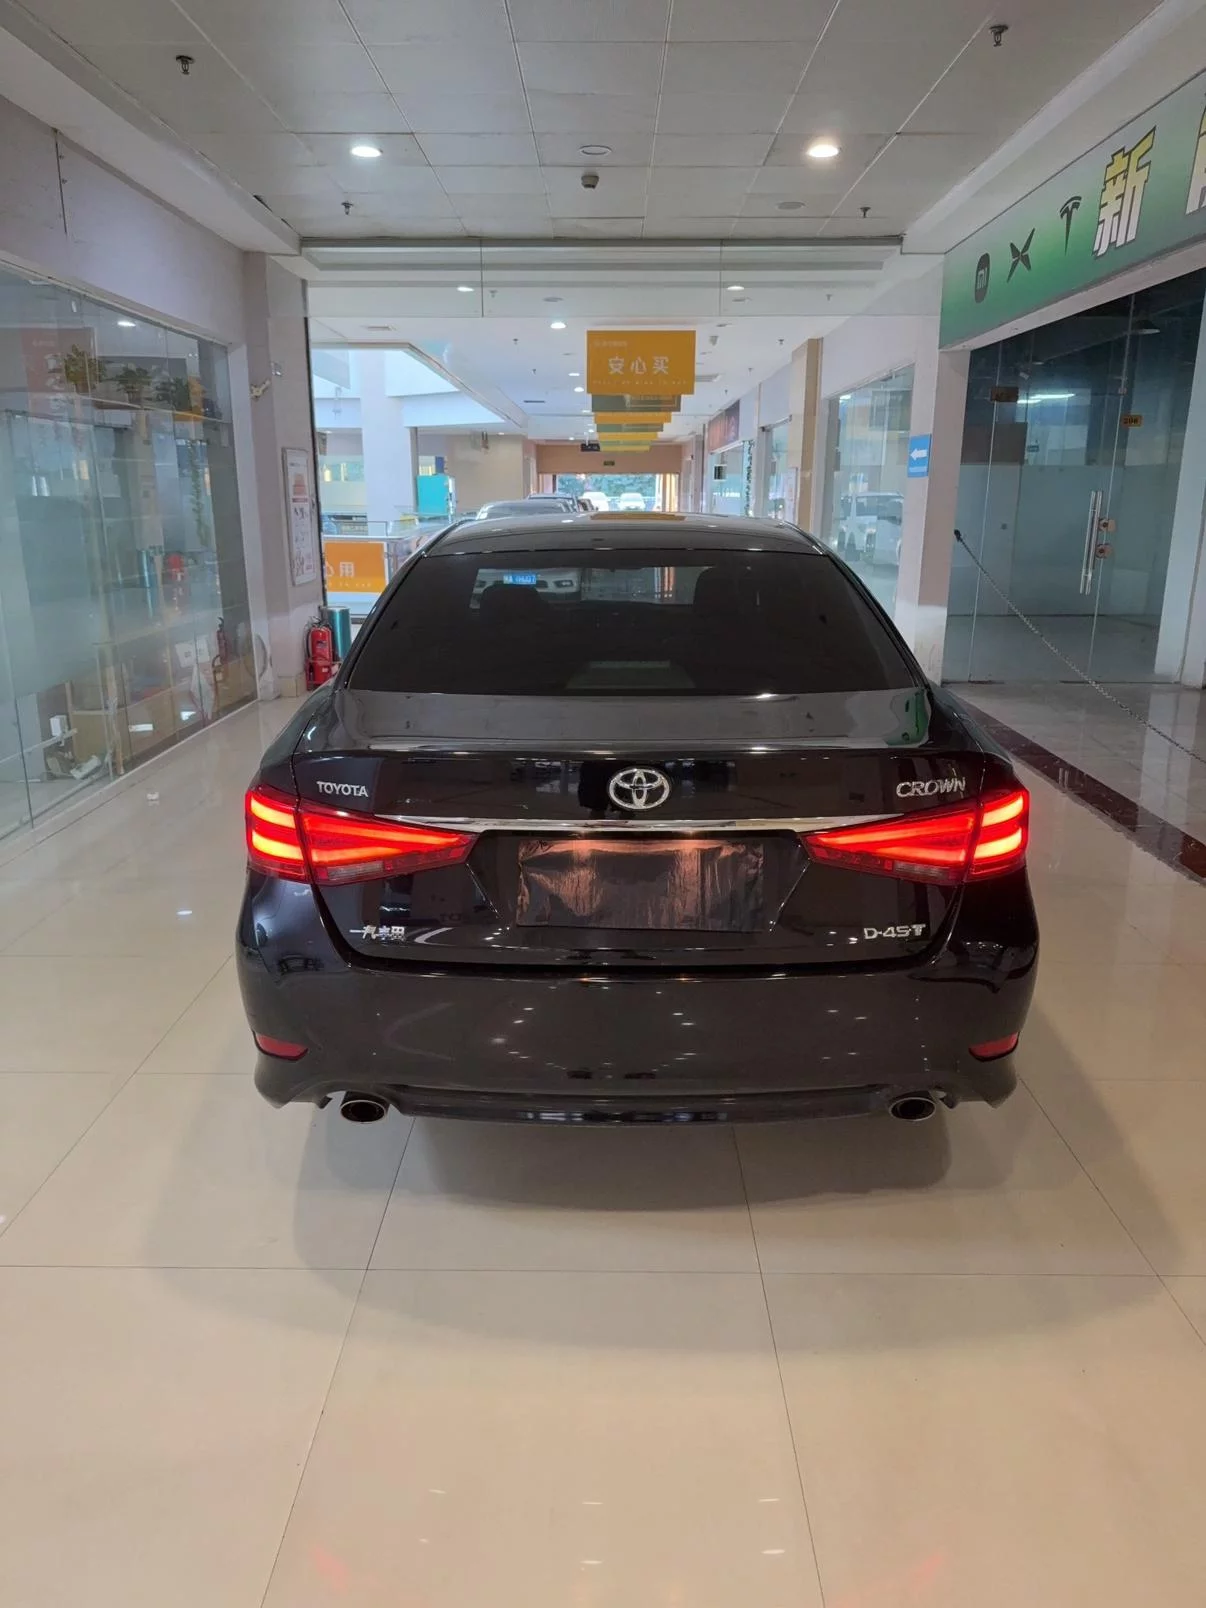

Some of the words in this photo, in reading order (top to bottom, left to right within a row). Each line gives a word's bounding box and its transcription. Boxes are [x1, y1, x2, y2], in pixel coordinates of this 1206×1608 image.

[608, 355, 669, 375] 安心买
[316, 781, 369, 797] TOYOTA
[896, 776, 966, 797] CROWN
